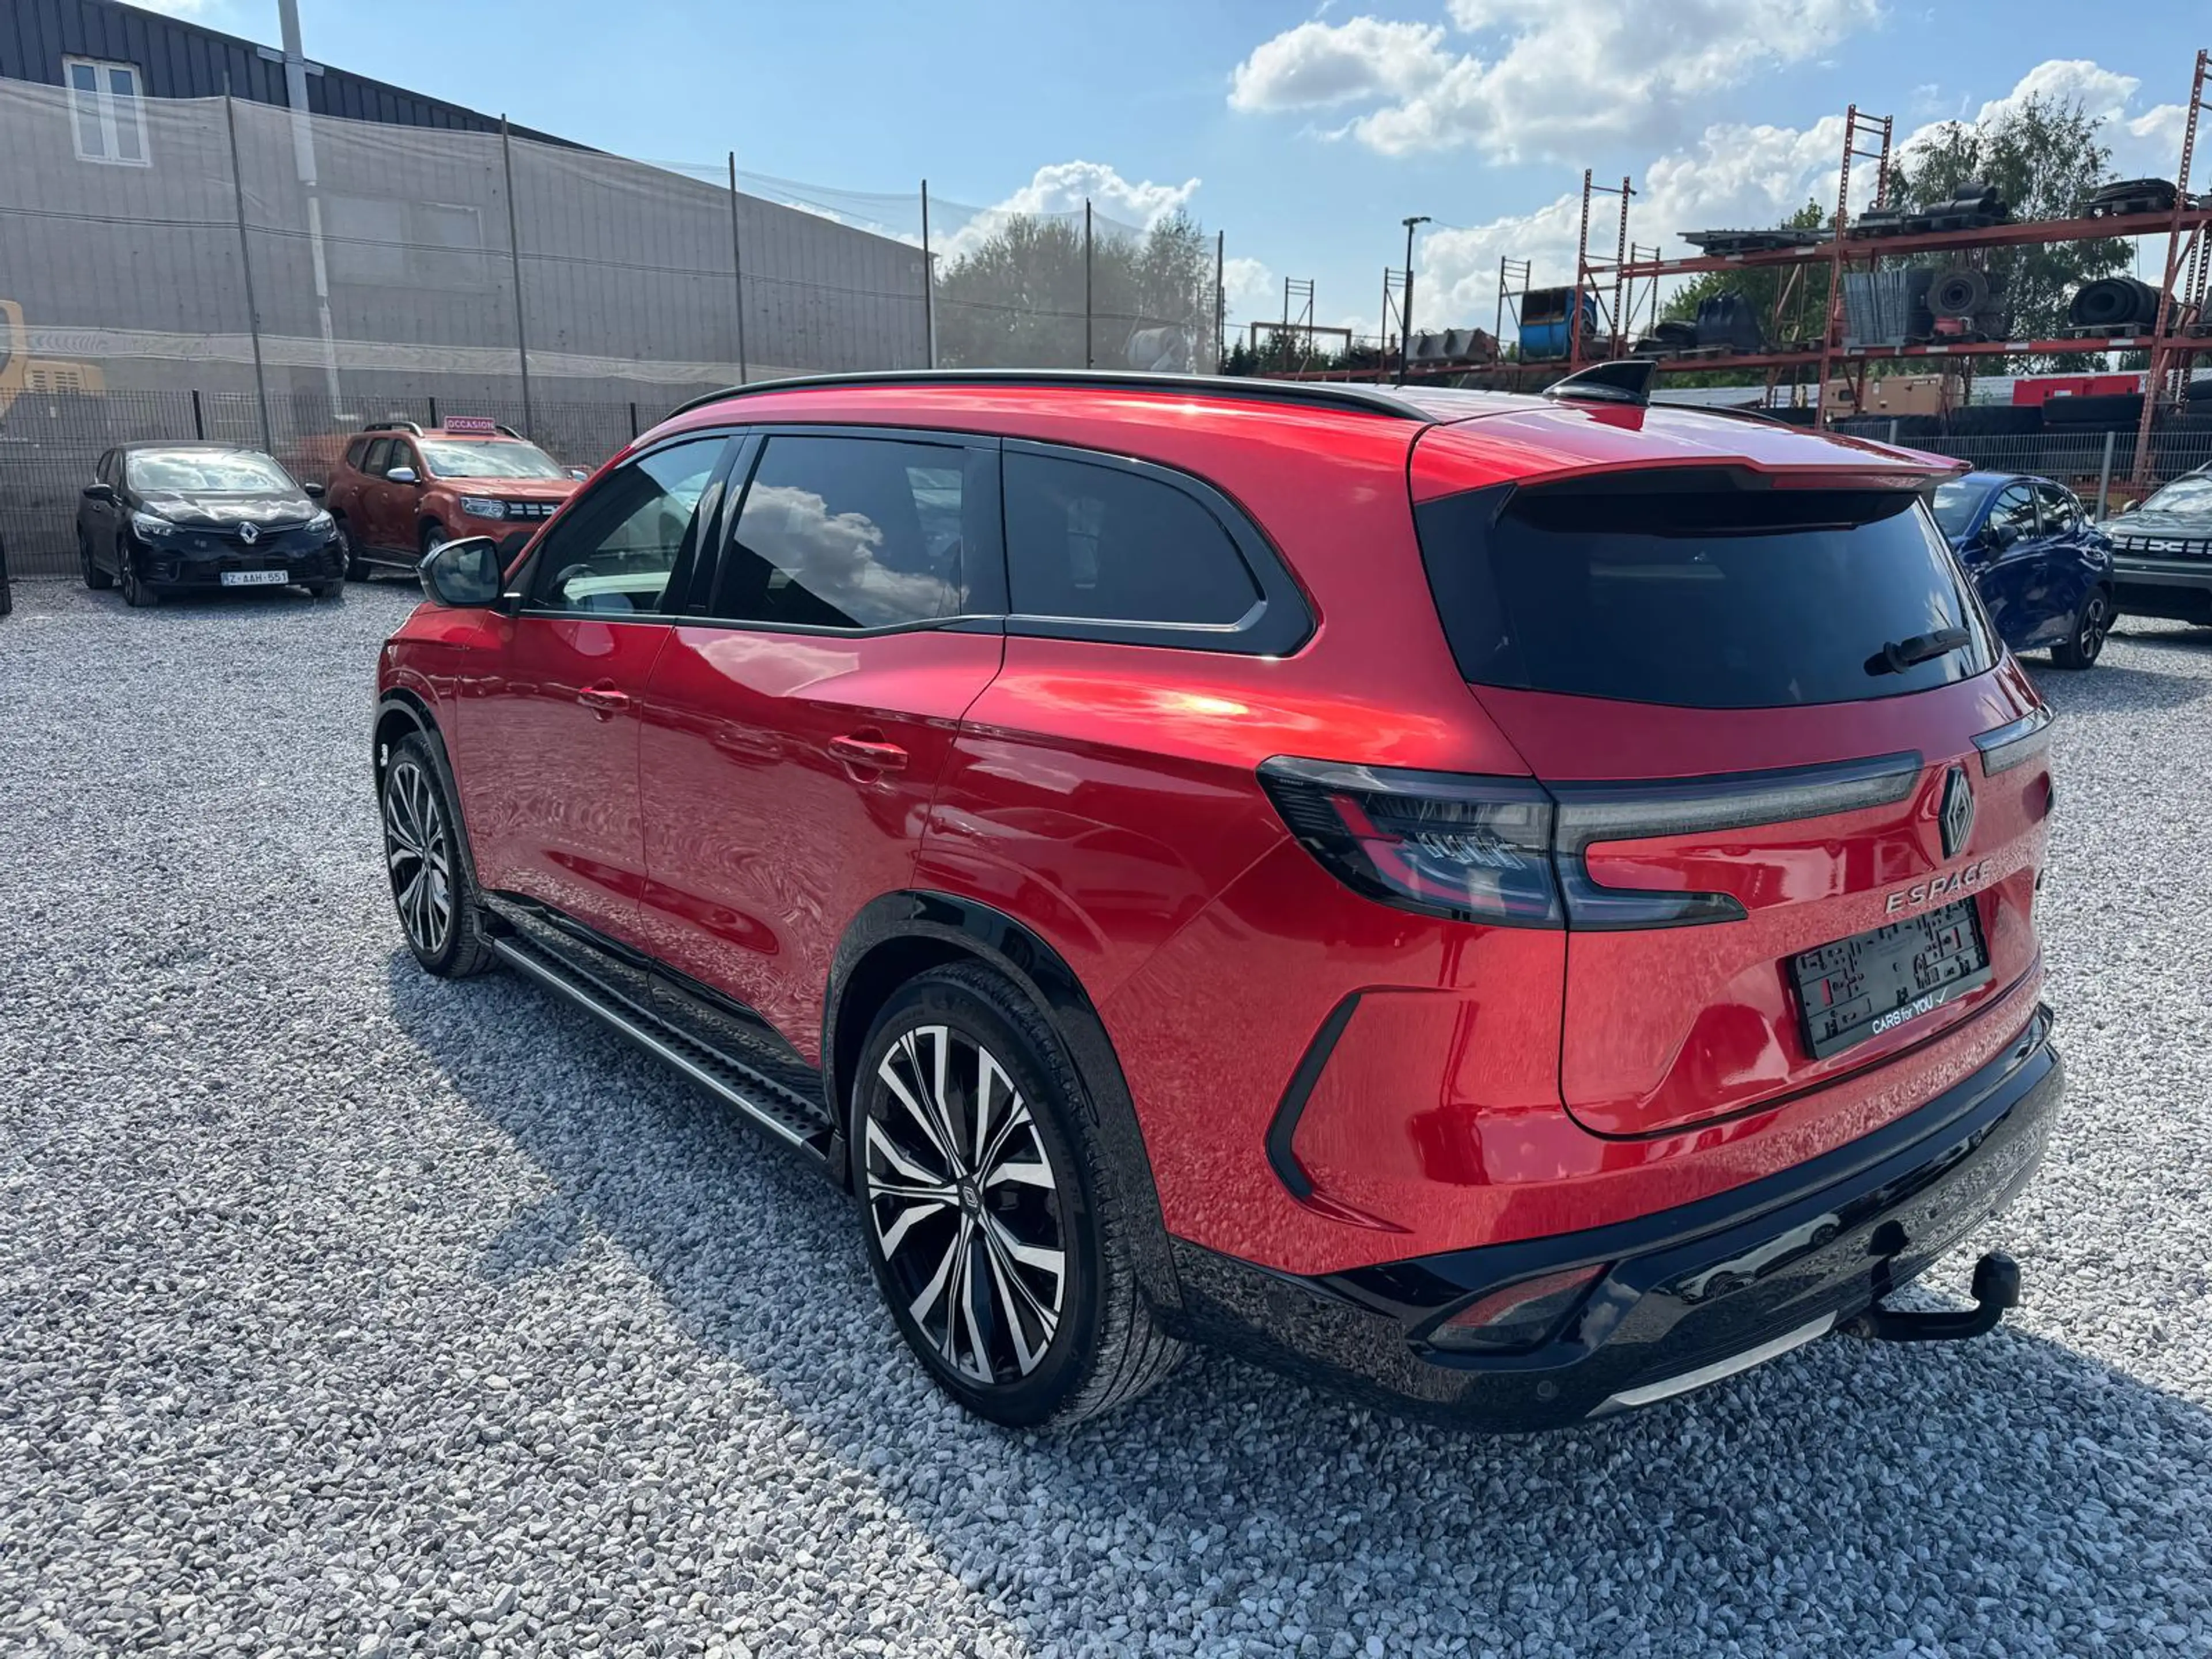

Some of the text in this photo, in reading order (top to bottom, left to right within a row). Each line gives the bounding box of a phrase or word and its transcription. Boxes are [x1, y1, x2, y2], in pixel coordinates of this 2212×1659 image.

[448, 420, 495, 429] OCCASION
[1884, 858, 1993, 914] ESPACE
[1872, 993, 1934, 1035] CARS for YOU
